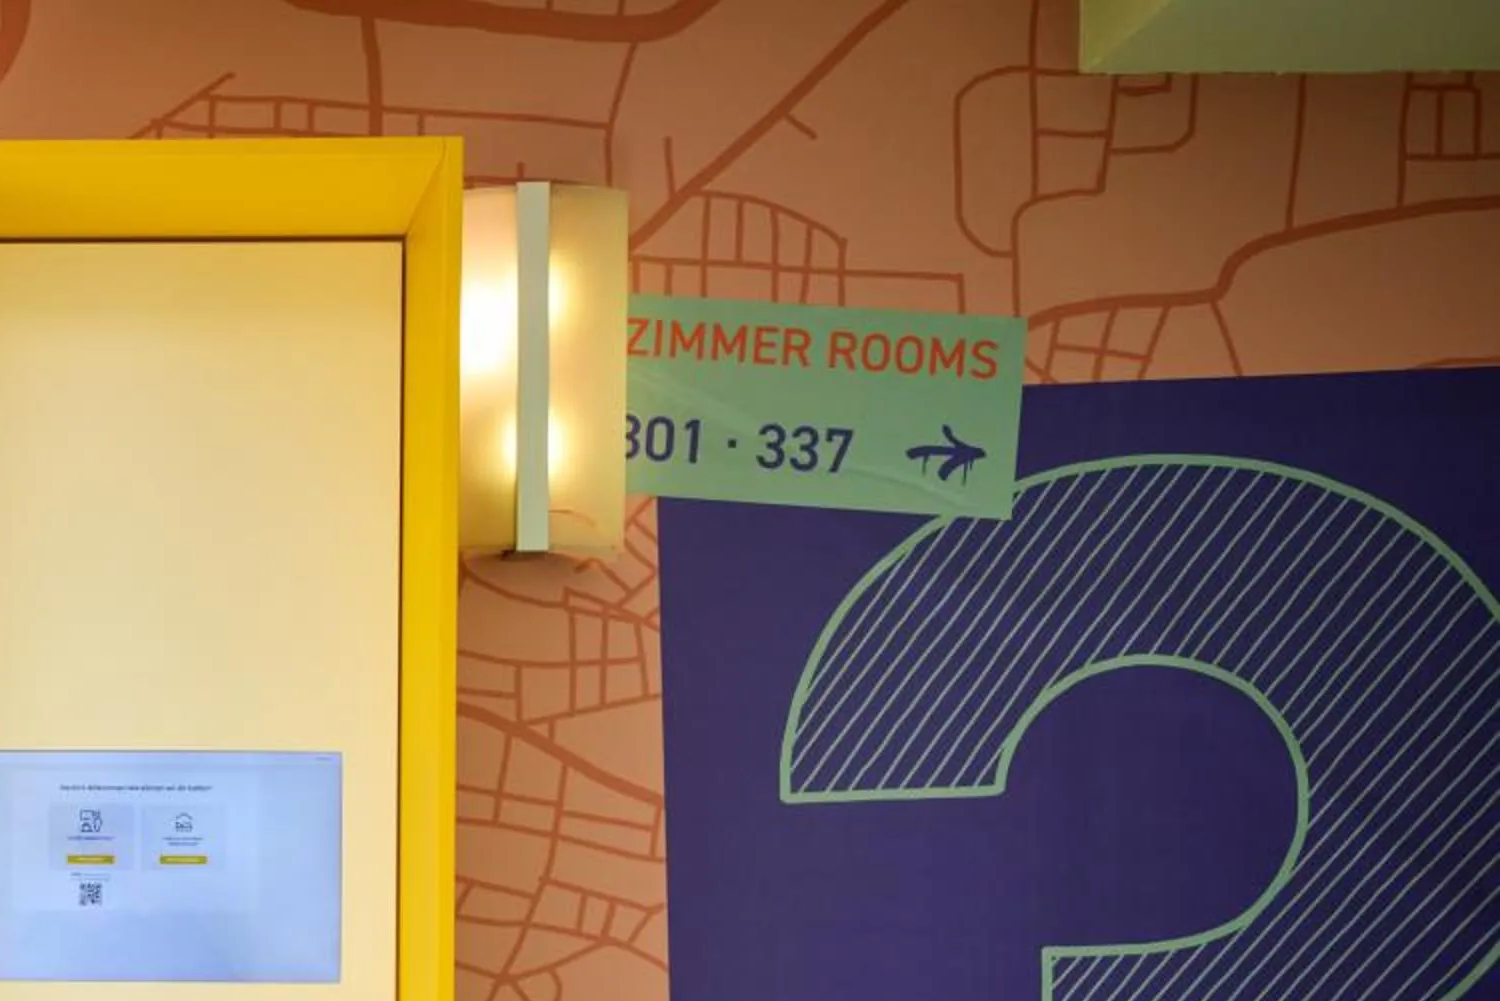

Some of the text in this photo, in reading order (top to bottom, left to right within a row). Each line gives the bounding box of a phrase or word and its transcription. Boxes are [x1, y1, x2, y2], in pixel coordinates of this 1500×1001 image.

[626, 317, 999, 380] ZIMMER ROOMS
[755, 422, 854, 473] 337
